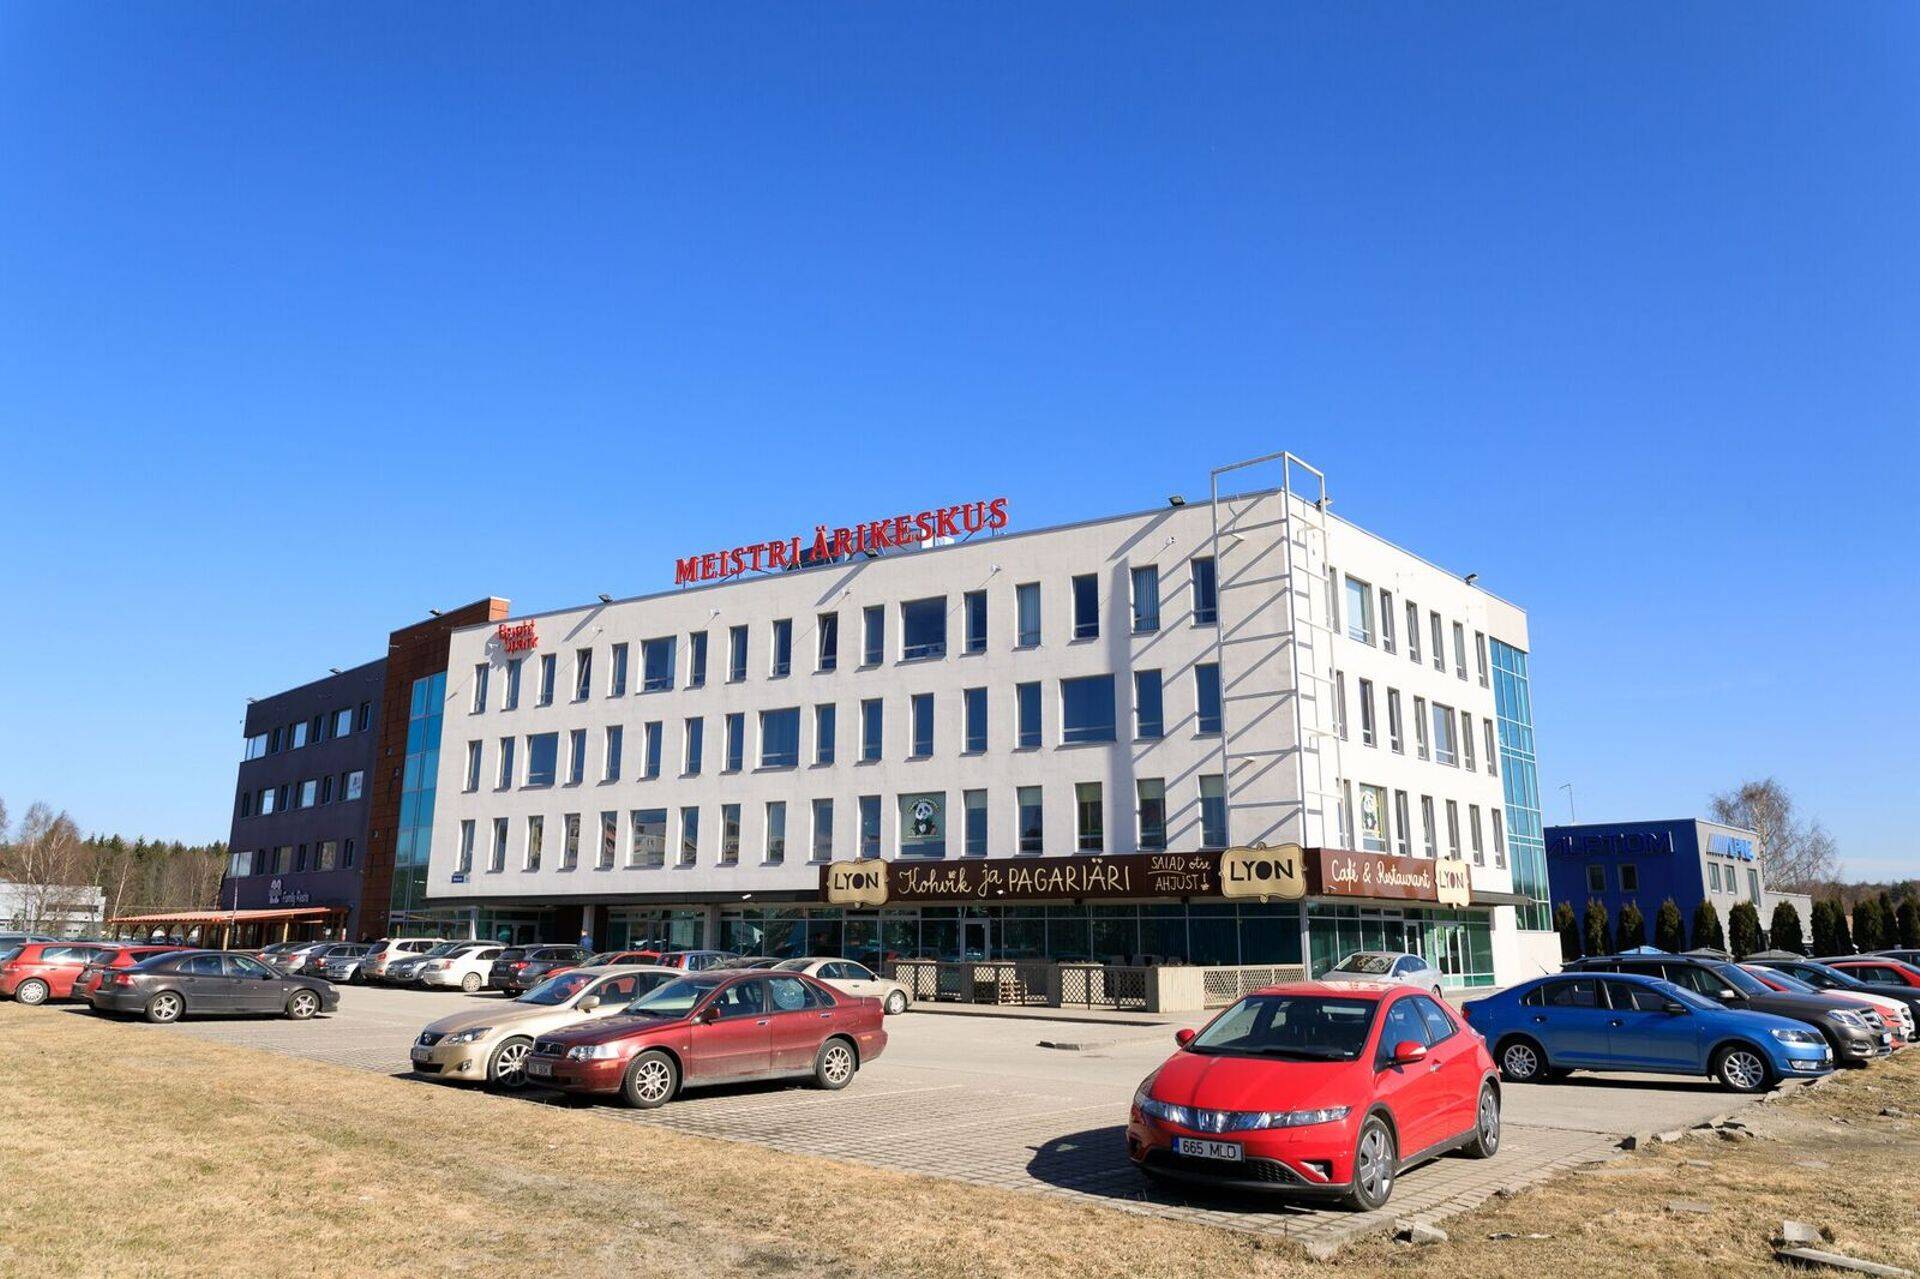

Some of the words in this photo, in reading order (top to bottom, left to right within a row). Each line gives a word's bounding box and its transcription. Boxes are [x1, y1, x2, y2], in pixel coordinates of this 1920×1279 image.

[675, 536, 802, 585] MEISTRI
[809, 498, 1009, 560] ÄRIKESKUS
[834, 871, 879, 890] LYON
[898, 866, 972, 895] Kohvik
[977, 863, 1003, 897] ja
[1008, 857, 1131, 893] PAGARIÄRI
[1230, 859, 1295, 881] LYON
[1331, 858, 1359, 892] Café
[1362, 861, 1372, 884] &
[1375, 860, 1431, 889] Restaurant
[1439, 869, 1465, 889] LYON
[1182, 1140, 1204, 1155] 665
[1210, 1143, 1237, 1160] MLD
